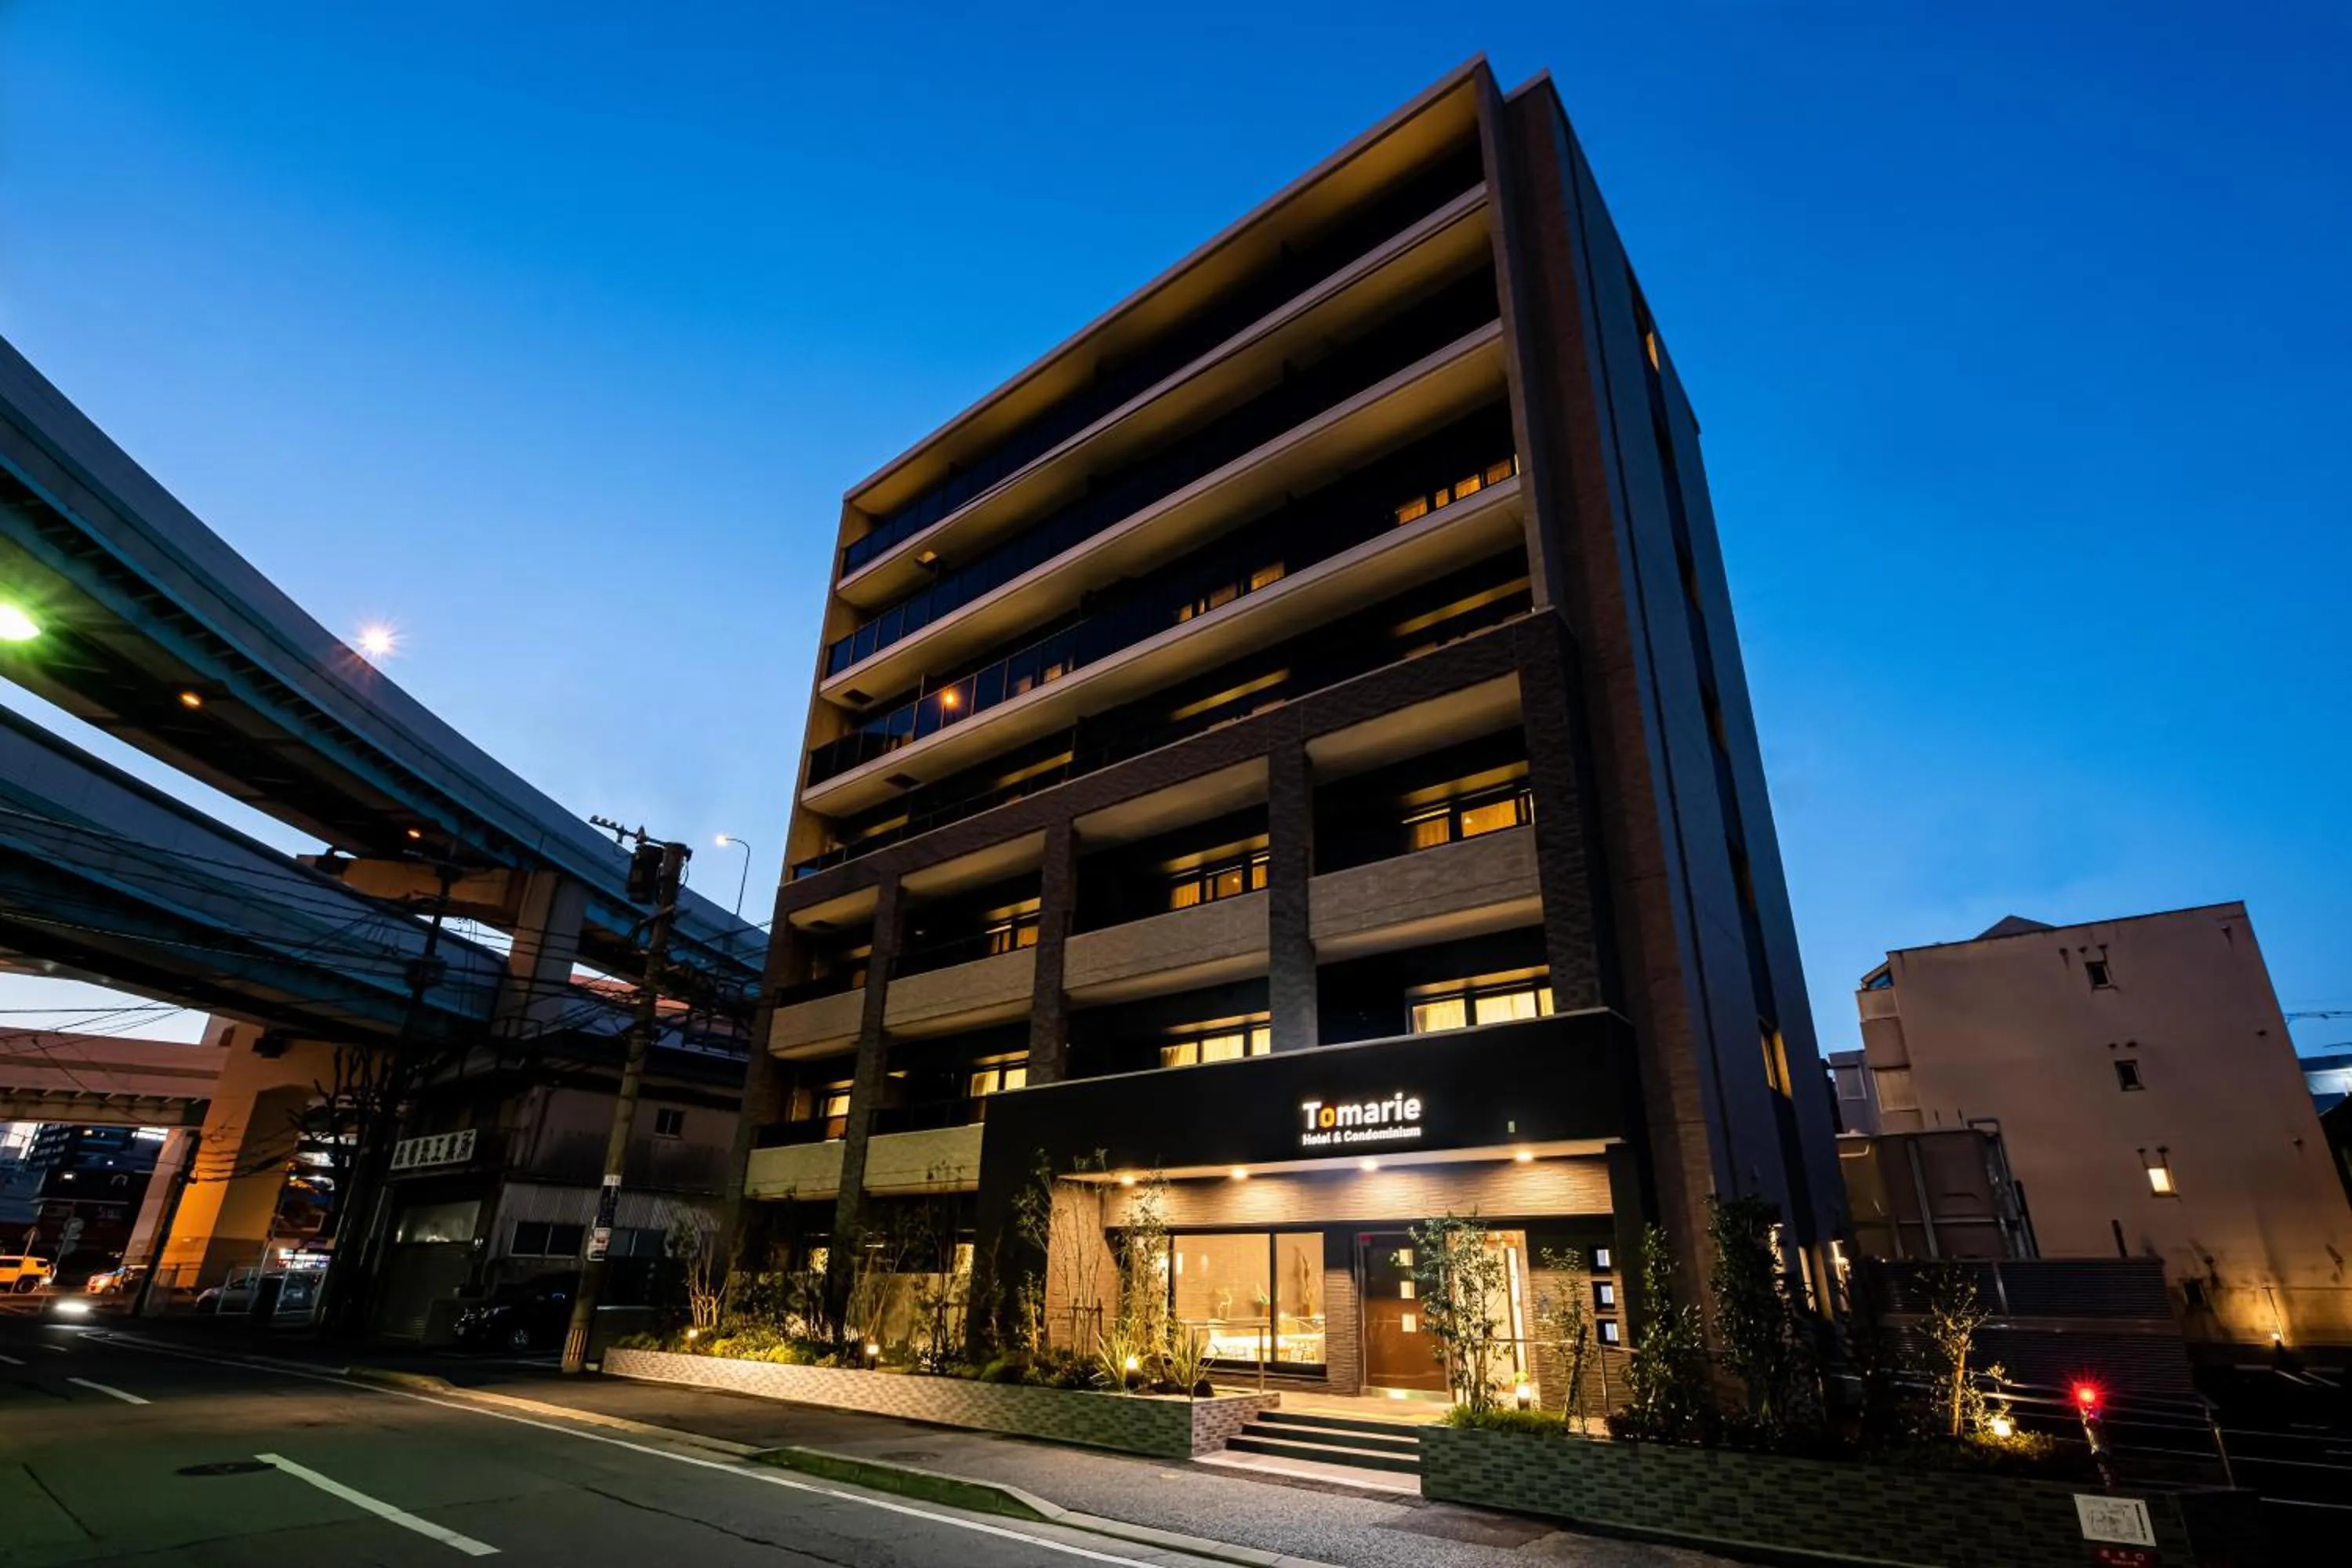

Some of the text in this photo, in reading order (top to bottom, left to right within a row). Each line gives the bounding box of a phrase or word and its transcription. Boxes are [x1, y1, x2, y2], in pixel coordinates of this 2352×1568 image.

[1302, 1092, 1421, 1129] Tomarie
[1302, 1127, 1421, 1145] Hotel & Condominium
